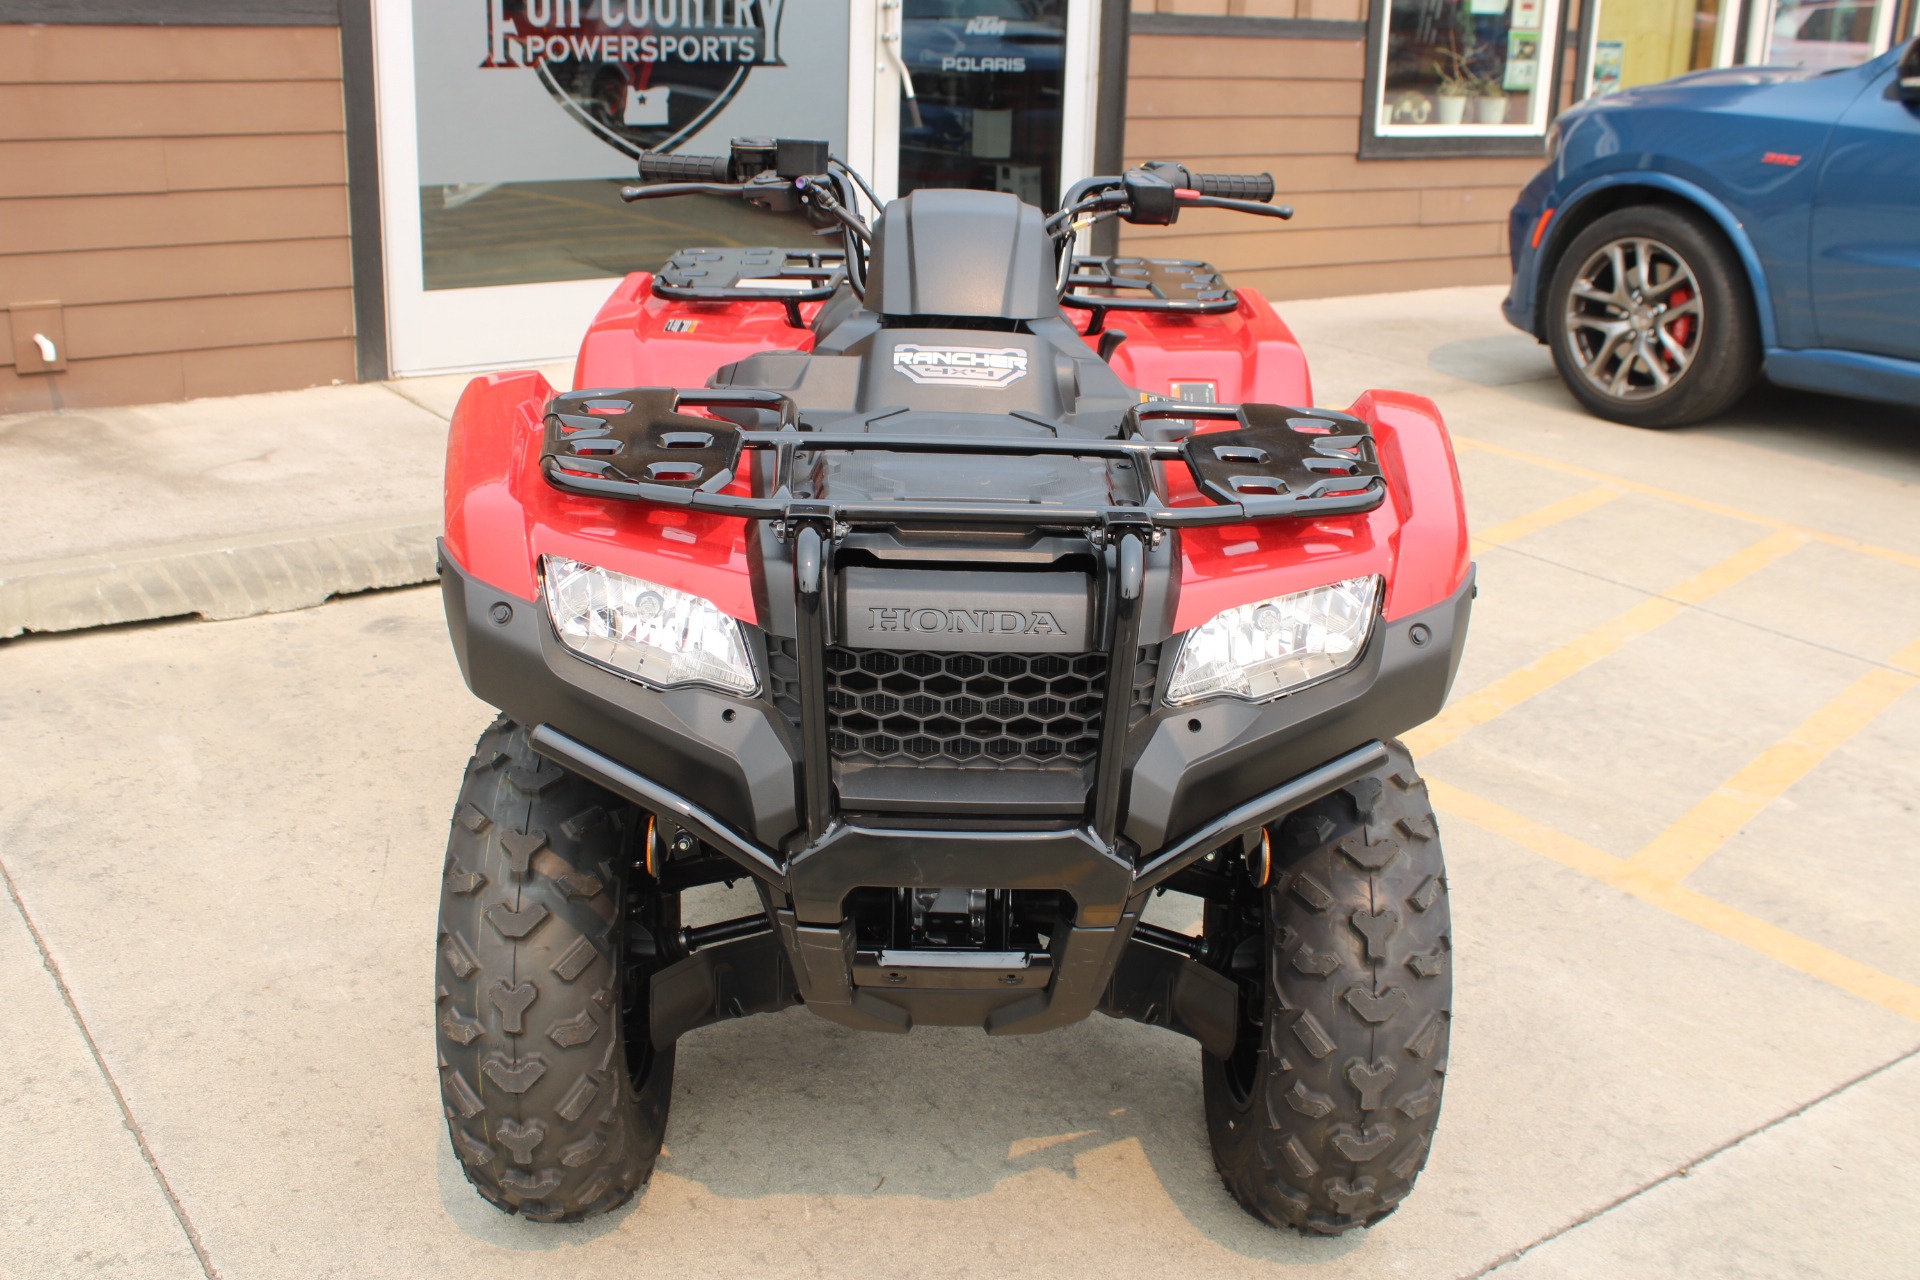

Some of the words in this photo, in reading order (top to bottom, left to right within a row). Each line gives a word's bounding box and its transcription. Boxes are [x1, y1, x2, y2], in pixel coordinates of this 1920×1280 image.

[965, 16, 1007, 35] KTM
[526, 35, 757, 63] POWERSPORTS
[942, 57, 1026, 72] POLARIS
[1761, 152, 1802, 167] 392
[893, 351, 1028, 370] RANCHER
[868, 607, 1067, 635] HONDA
